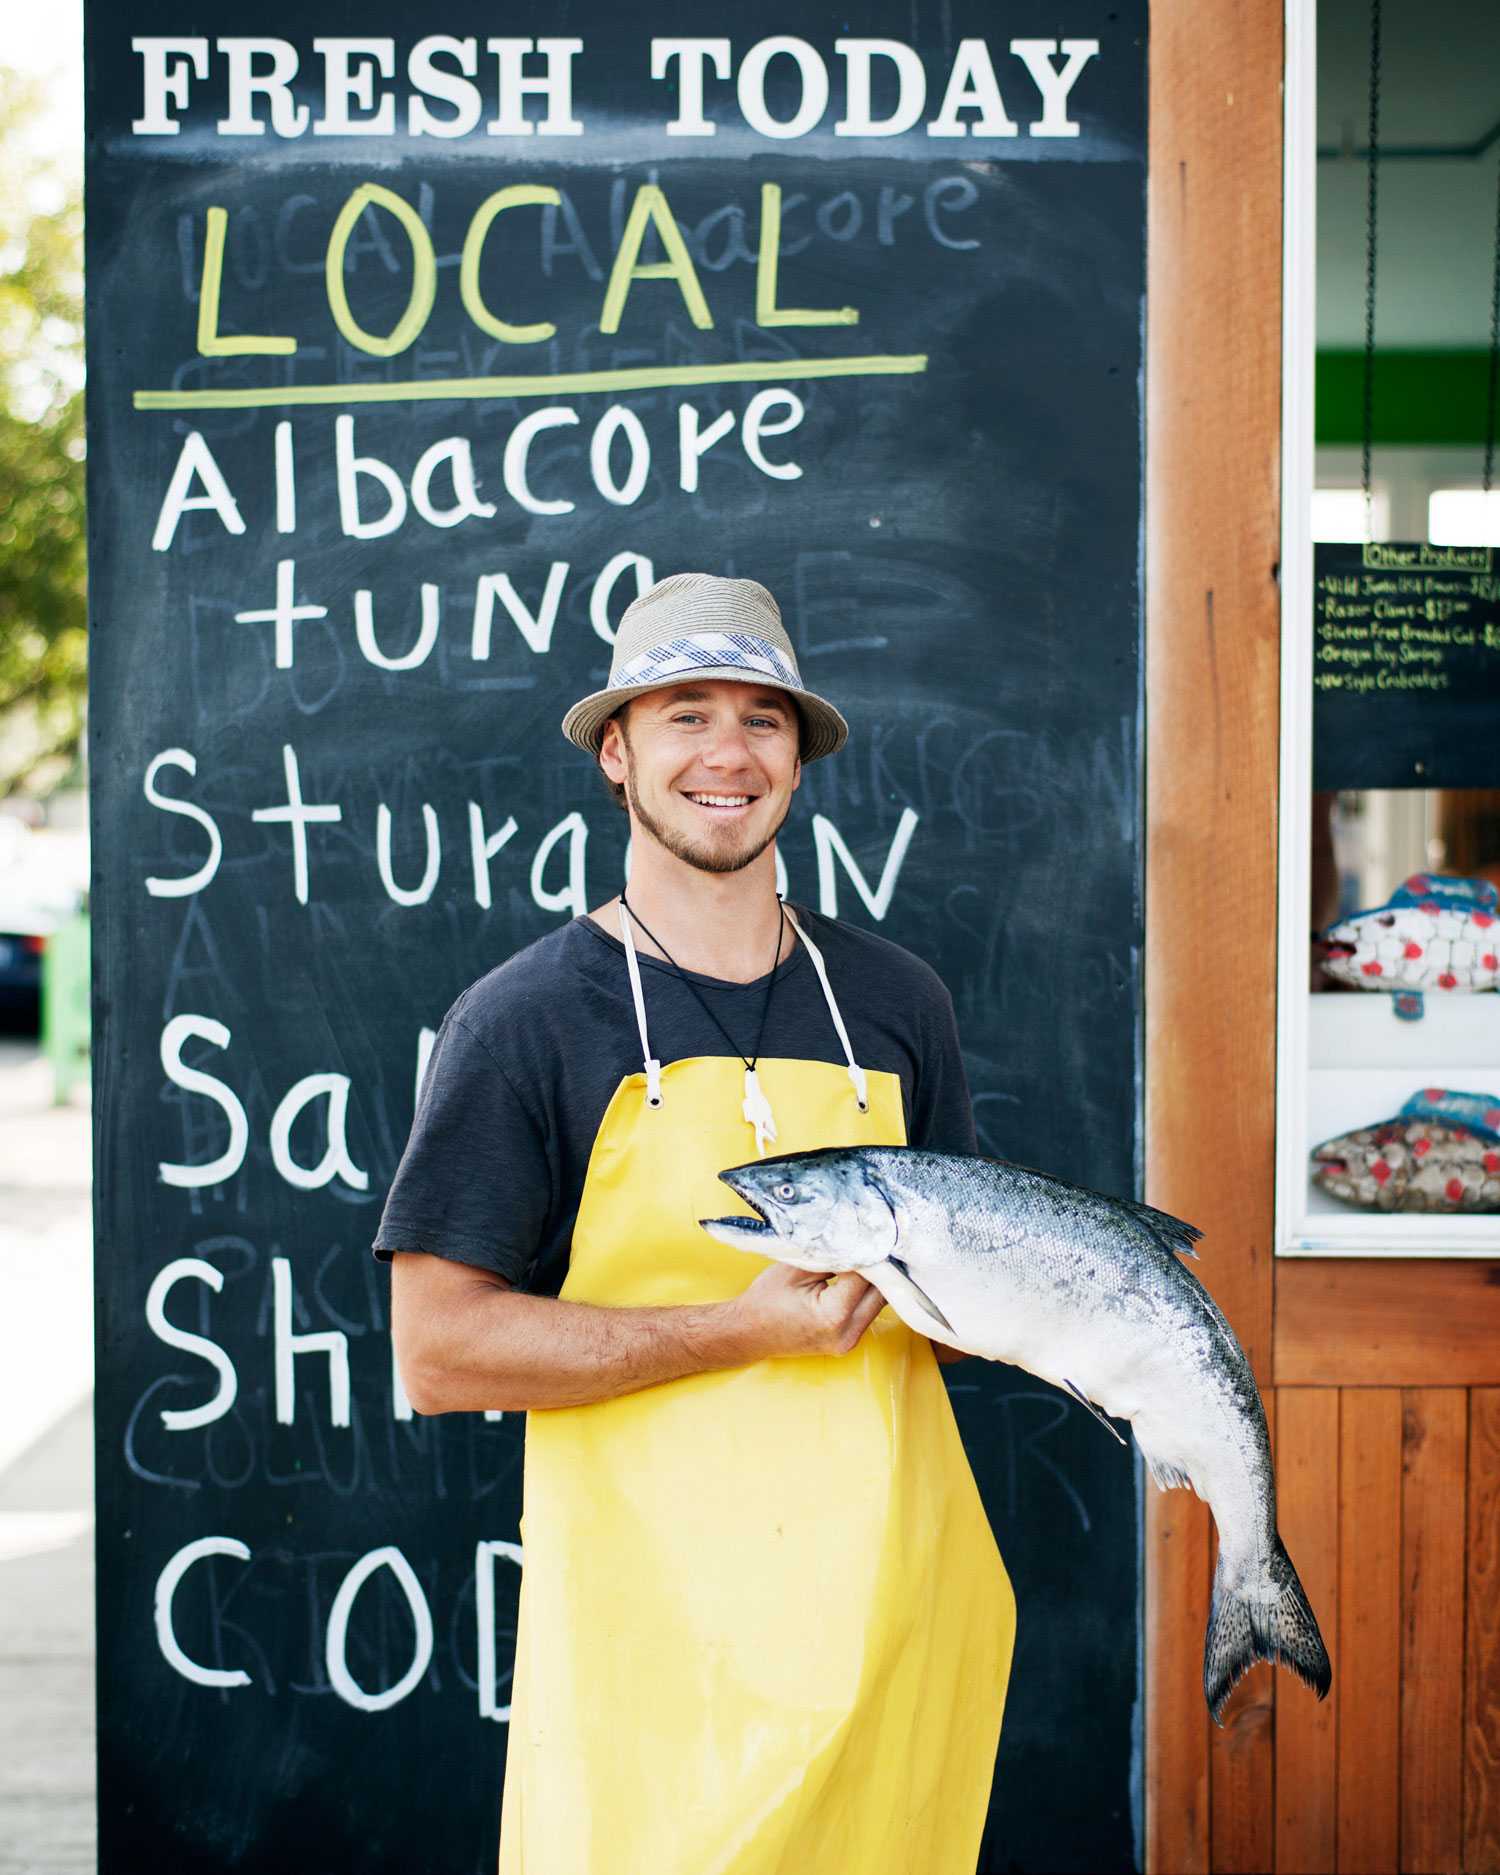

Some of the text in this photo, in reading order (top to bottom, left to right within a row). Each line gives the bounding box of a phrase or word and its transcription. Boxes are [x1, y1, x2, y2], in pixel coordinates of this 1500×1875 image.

[132, 35, 1099, 139] FRESH TODAY
[197, 182, 859, 359] LOCAL
[152, 388, 804, 552] Albacore
